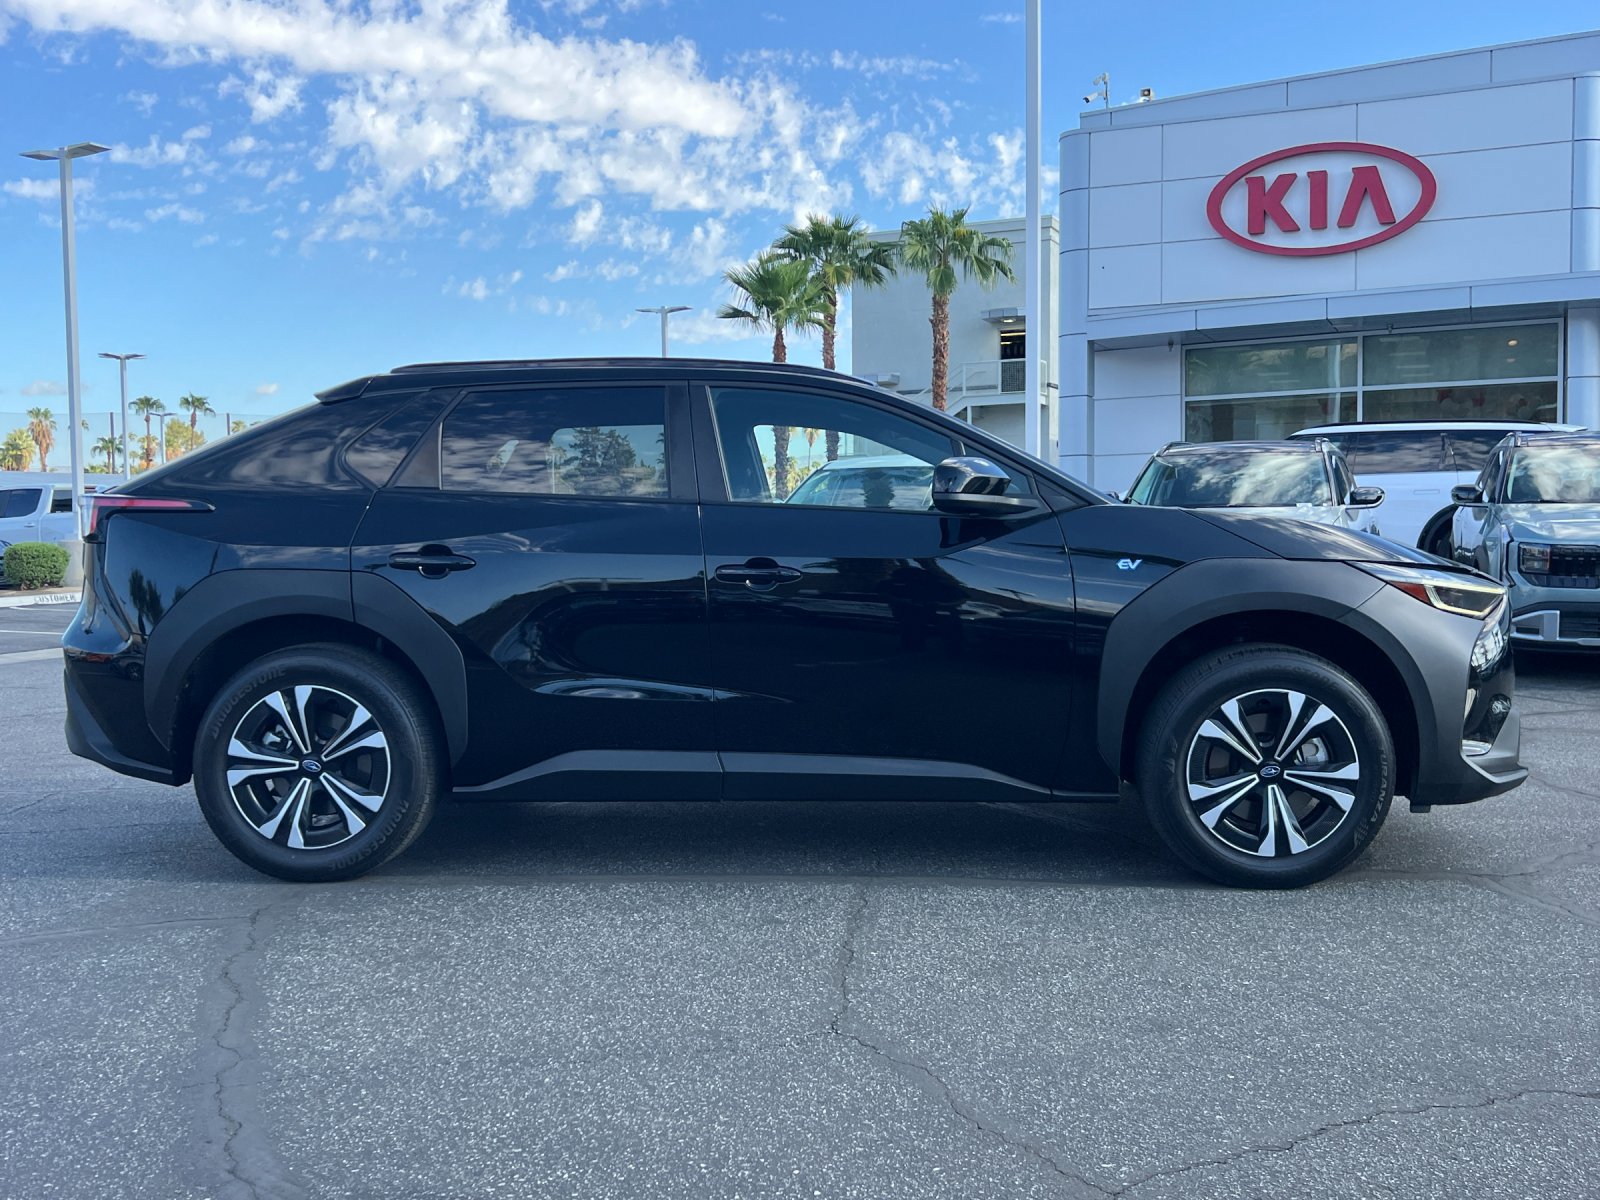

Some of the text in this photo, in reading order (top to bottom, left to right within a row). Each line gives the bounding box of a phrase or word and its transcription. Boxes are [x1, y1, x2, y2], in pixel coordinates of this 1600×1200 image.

[1245, 165, 1396, 235] KIA
[33, 593, 77, 603] CUSTOMER
[1117, 558, 1142, 569] EV
[209, 667, 287, 740] BRIDGESTONE
[1369, 747, 1389, 823] TURANZA
[328, 799, 410, 872] BRIDGESTONE
